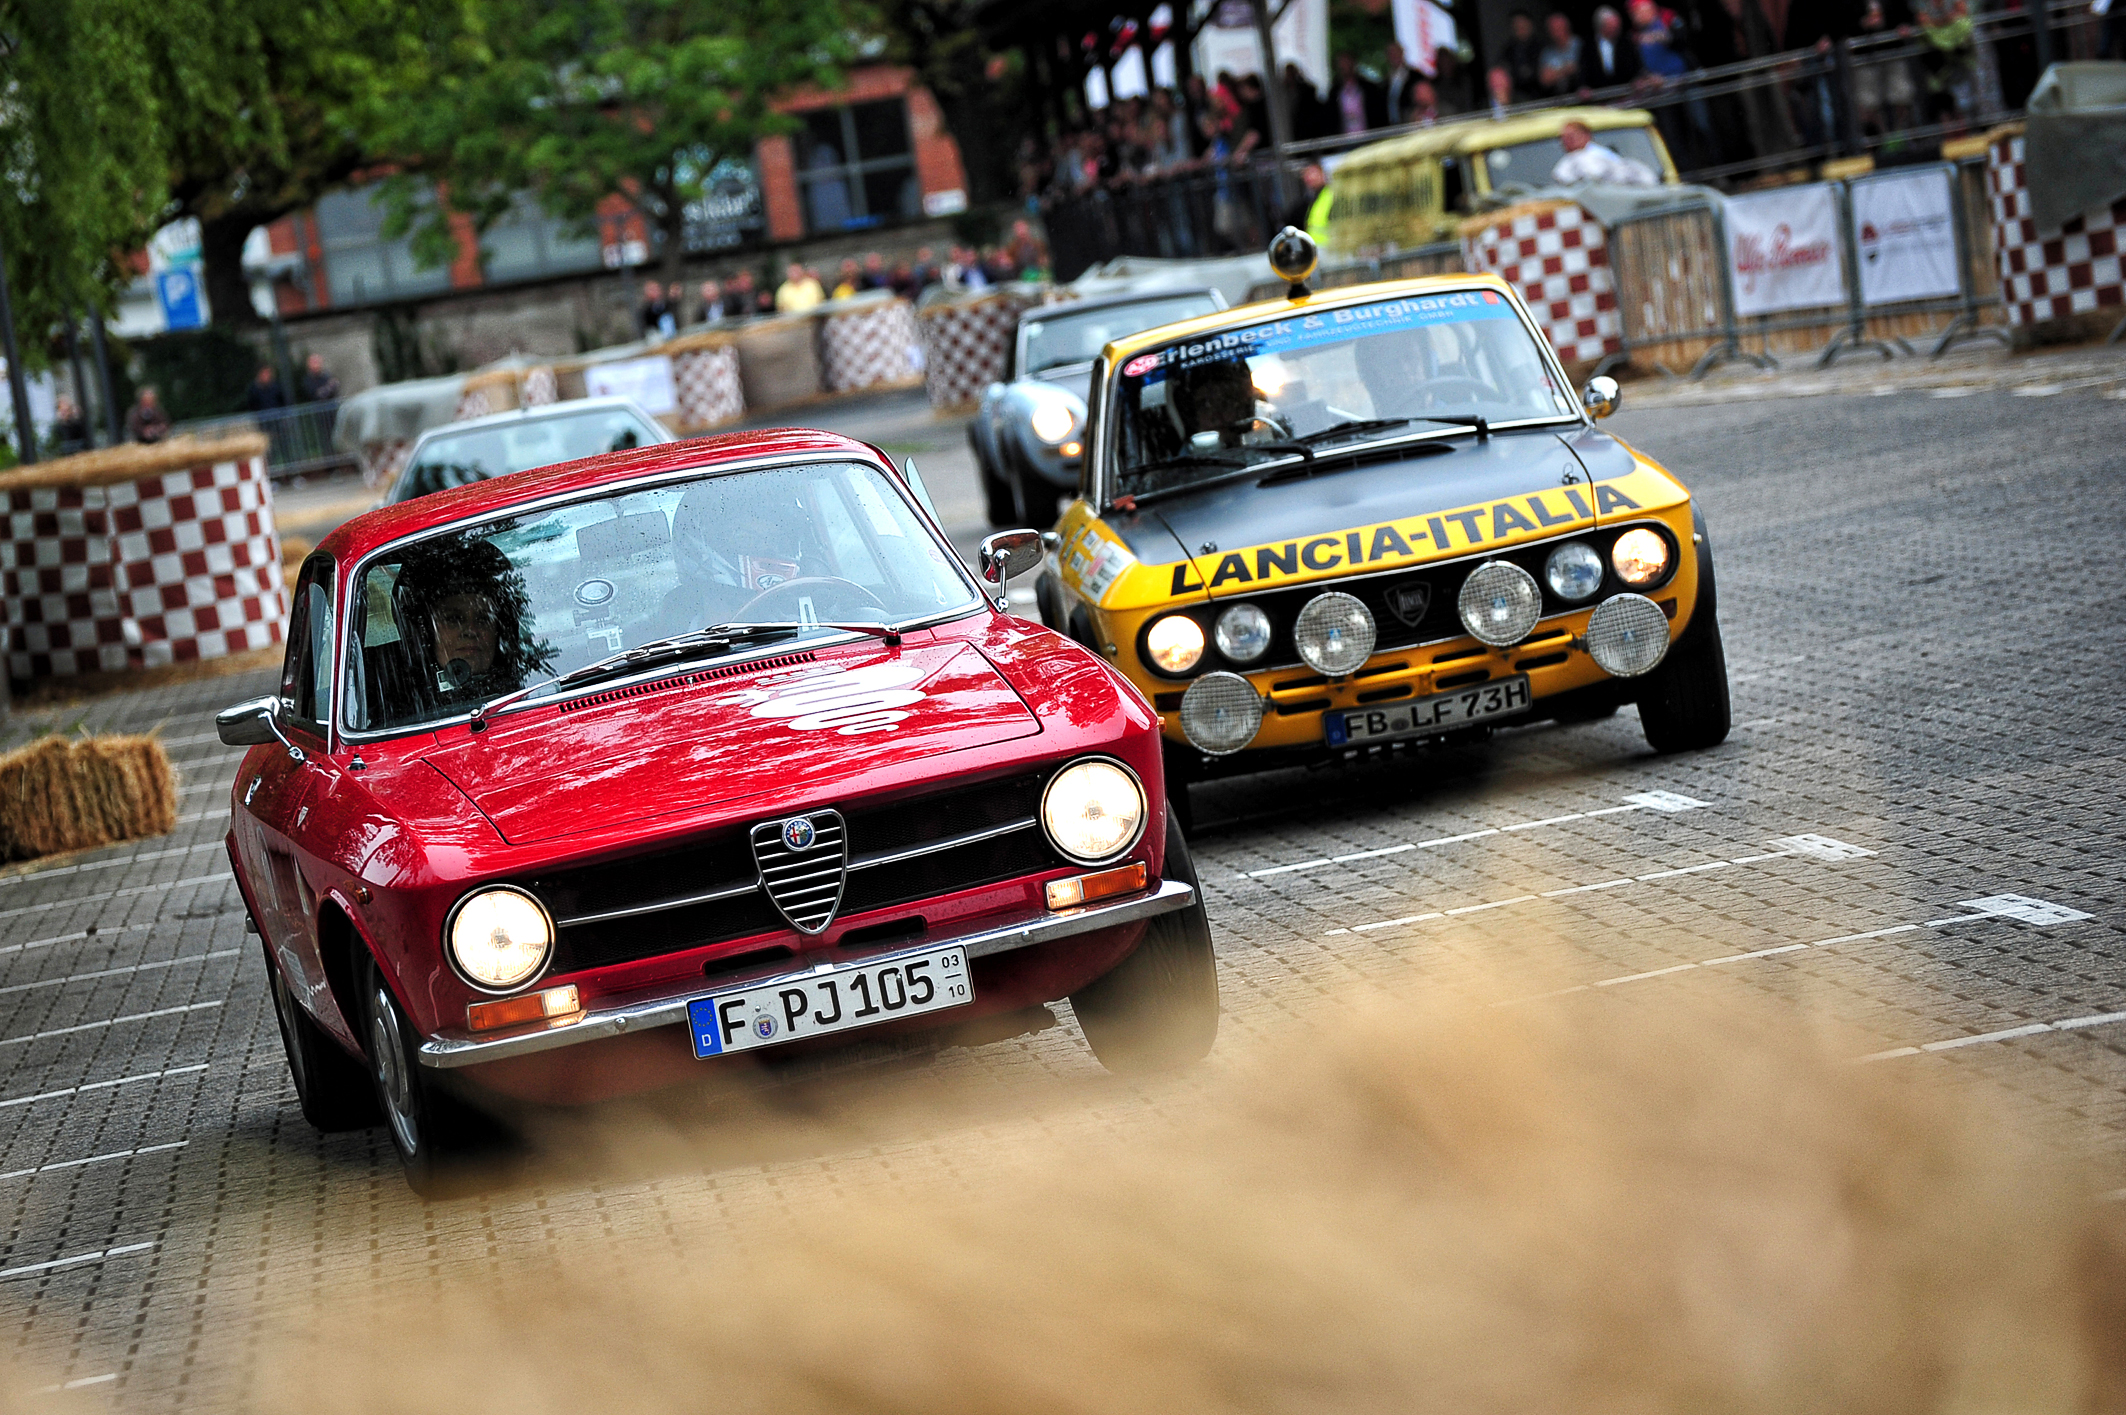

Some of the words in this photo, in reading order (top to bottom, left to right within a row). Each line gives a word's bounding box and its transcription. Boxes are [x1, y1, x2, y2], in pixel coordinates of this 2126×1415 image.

[1155, 321, 1292, 367] Erlenbeck
[1303, 314, 1325, 331] &
[1332, 292, 1479, 325] Burghardt
[1170, 485, 1641, 596] LANCIA-ITALIA
[1345, 711, 1388, 739] FB
[1410, 699, 1454, 728] LF
[1460, 681, 1528, 719] 73H
[941, 954, 960, 969] 03
[948, 983, 966, 999] 10
[701, 1033, 712, 1047] D
[718, 998, 746, 1045] F
